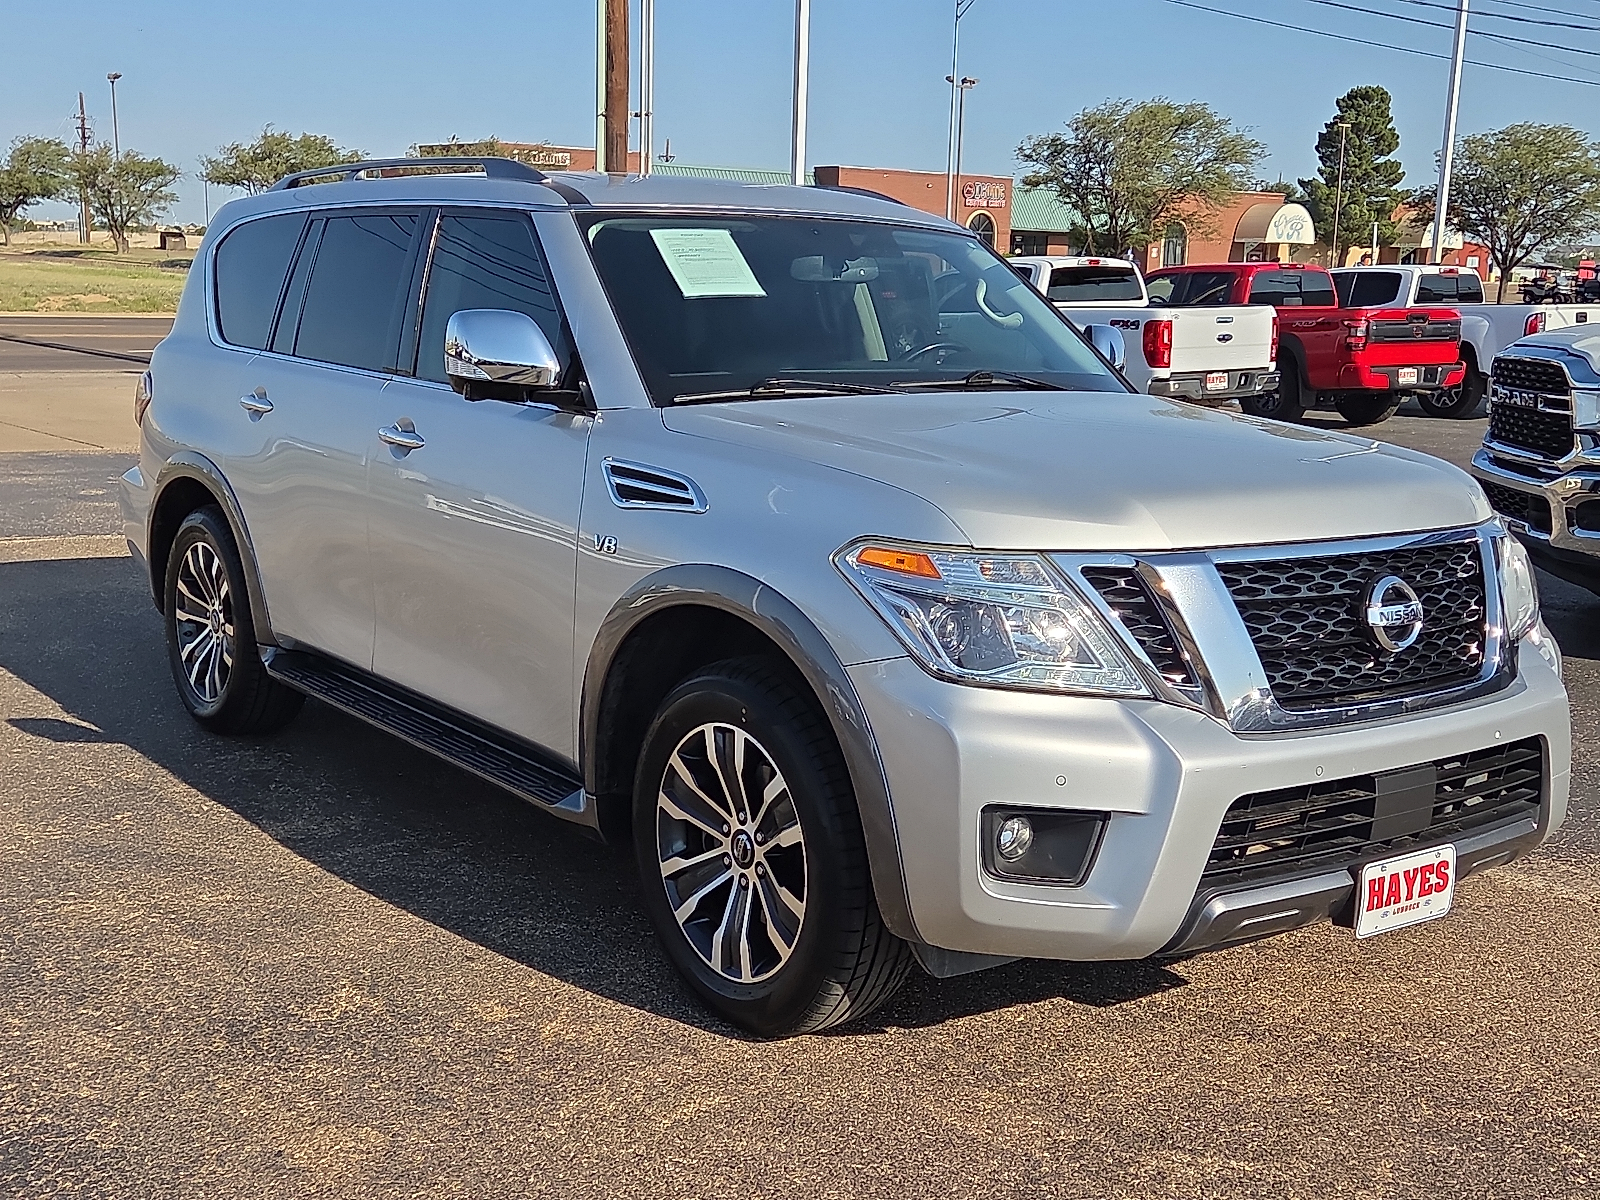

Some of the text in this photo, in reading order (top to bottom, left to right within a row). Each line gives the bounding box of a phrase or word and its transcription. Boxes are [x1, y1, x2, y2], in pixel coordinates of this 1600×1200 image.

[1498, 386, 1535, 407] RAM
[594, 533, 618, 554] V8
[1379, 604, 1423, 622] NISSAN
[1366, 860, 1450, 912] HAYES
[1392, 901, 1421, 915] LUBBOCK
